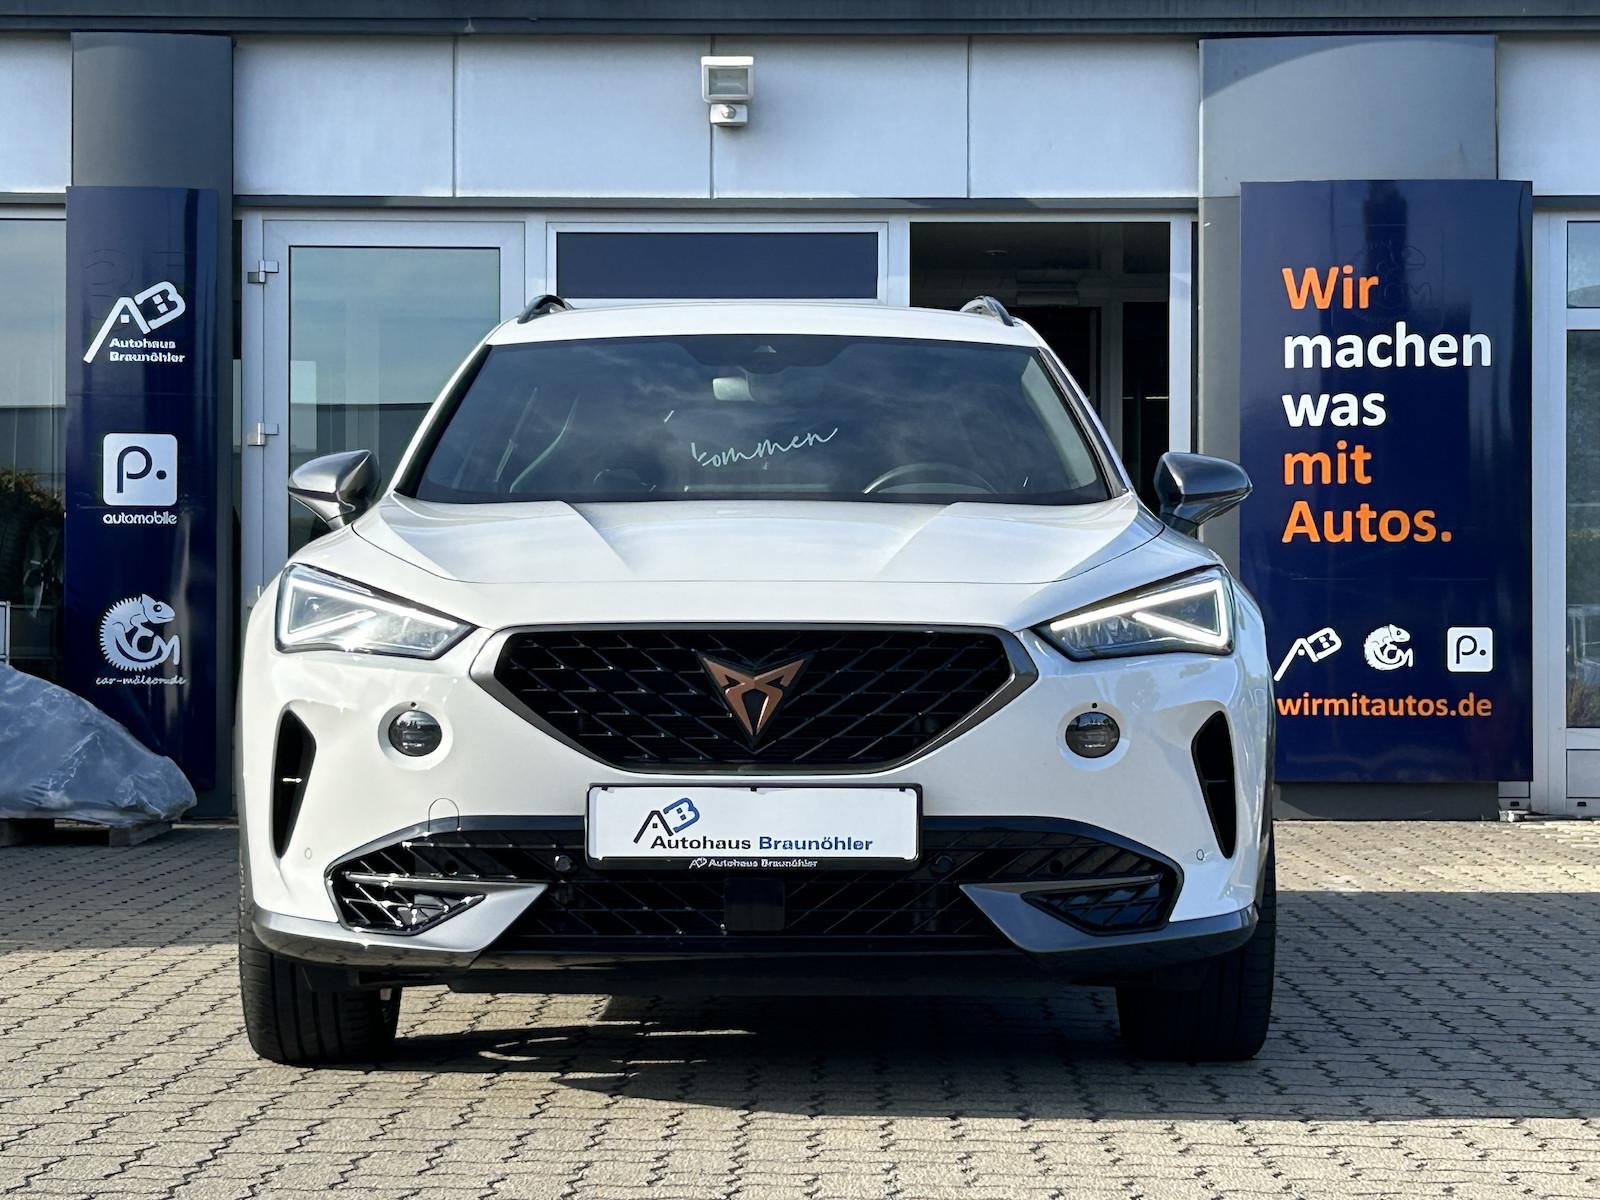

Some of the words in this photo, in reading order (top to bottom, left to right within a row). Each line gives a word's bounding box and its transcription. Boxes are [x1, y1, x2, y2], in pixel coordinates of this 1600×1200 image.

[1281, 264, 1380, 310] Wir
[109, 338, 176, 349] Autohaus
[1283, 320, 1492, 369] machen
[109, 351, 185, 363] Braunöhler
[1281, 392, 1387, 427] was
[1283, 439, 1373, 486] mit
[102, 511, 178, 525] automobile
[1281, 500, 1453, 544] Autos.
[1276, 692, 1493, 717] wirmitautos.de
[650, 835, 751, 850] Autohaus
[759, 835, 874, 851] Braunöhler
[708, 858, 758, 868] Autohaus
